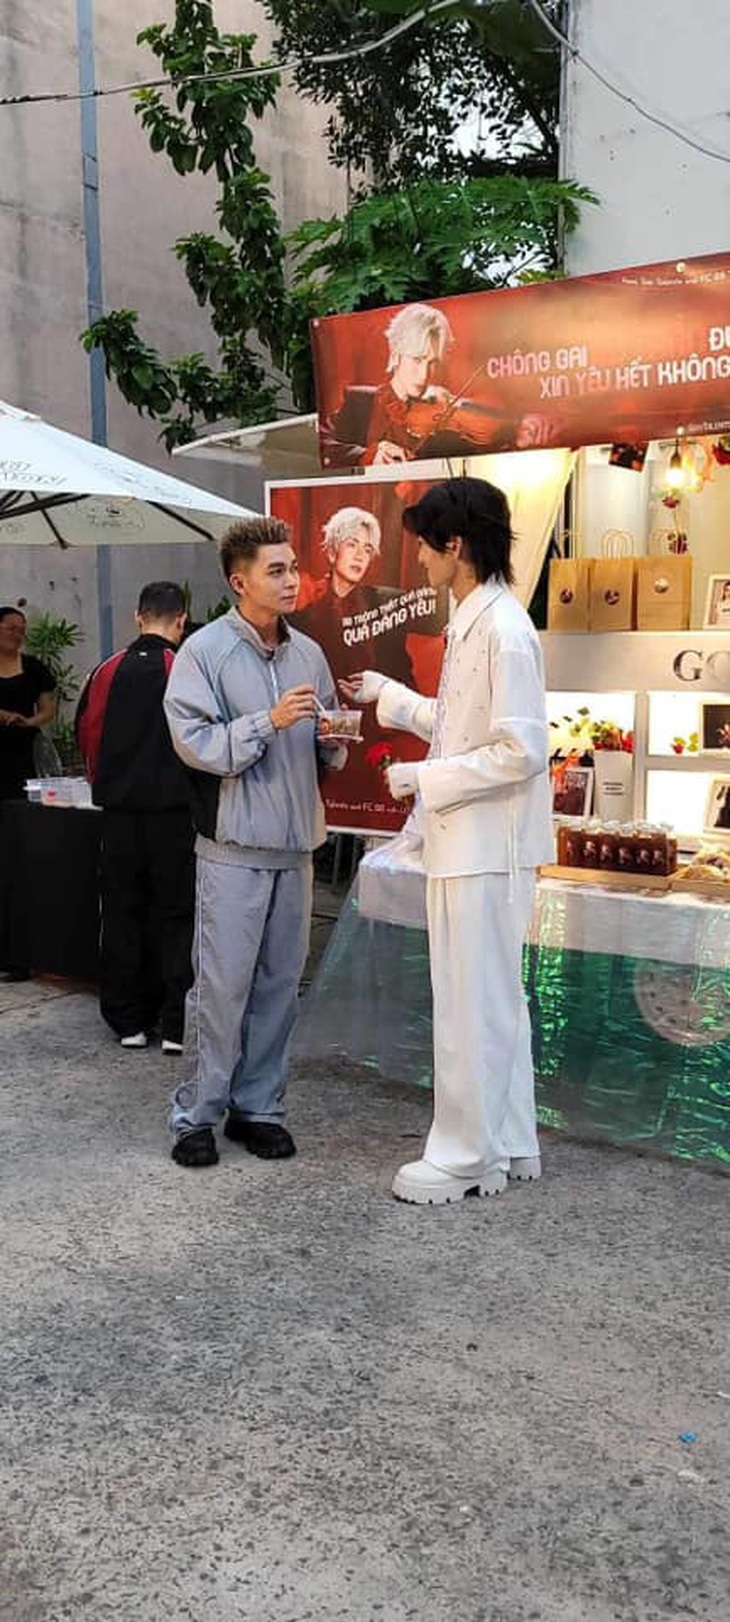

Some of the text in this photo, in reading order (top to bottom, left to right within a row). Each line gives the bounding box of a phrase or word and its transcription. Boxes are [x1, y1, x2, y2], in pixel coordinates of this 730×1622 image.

[486, 348, 551, 379] CHÔNG
[556, 344, 588, 371] GAI
[540, 353, 730, 399] XIN YÊU HẾT KHÔNG
